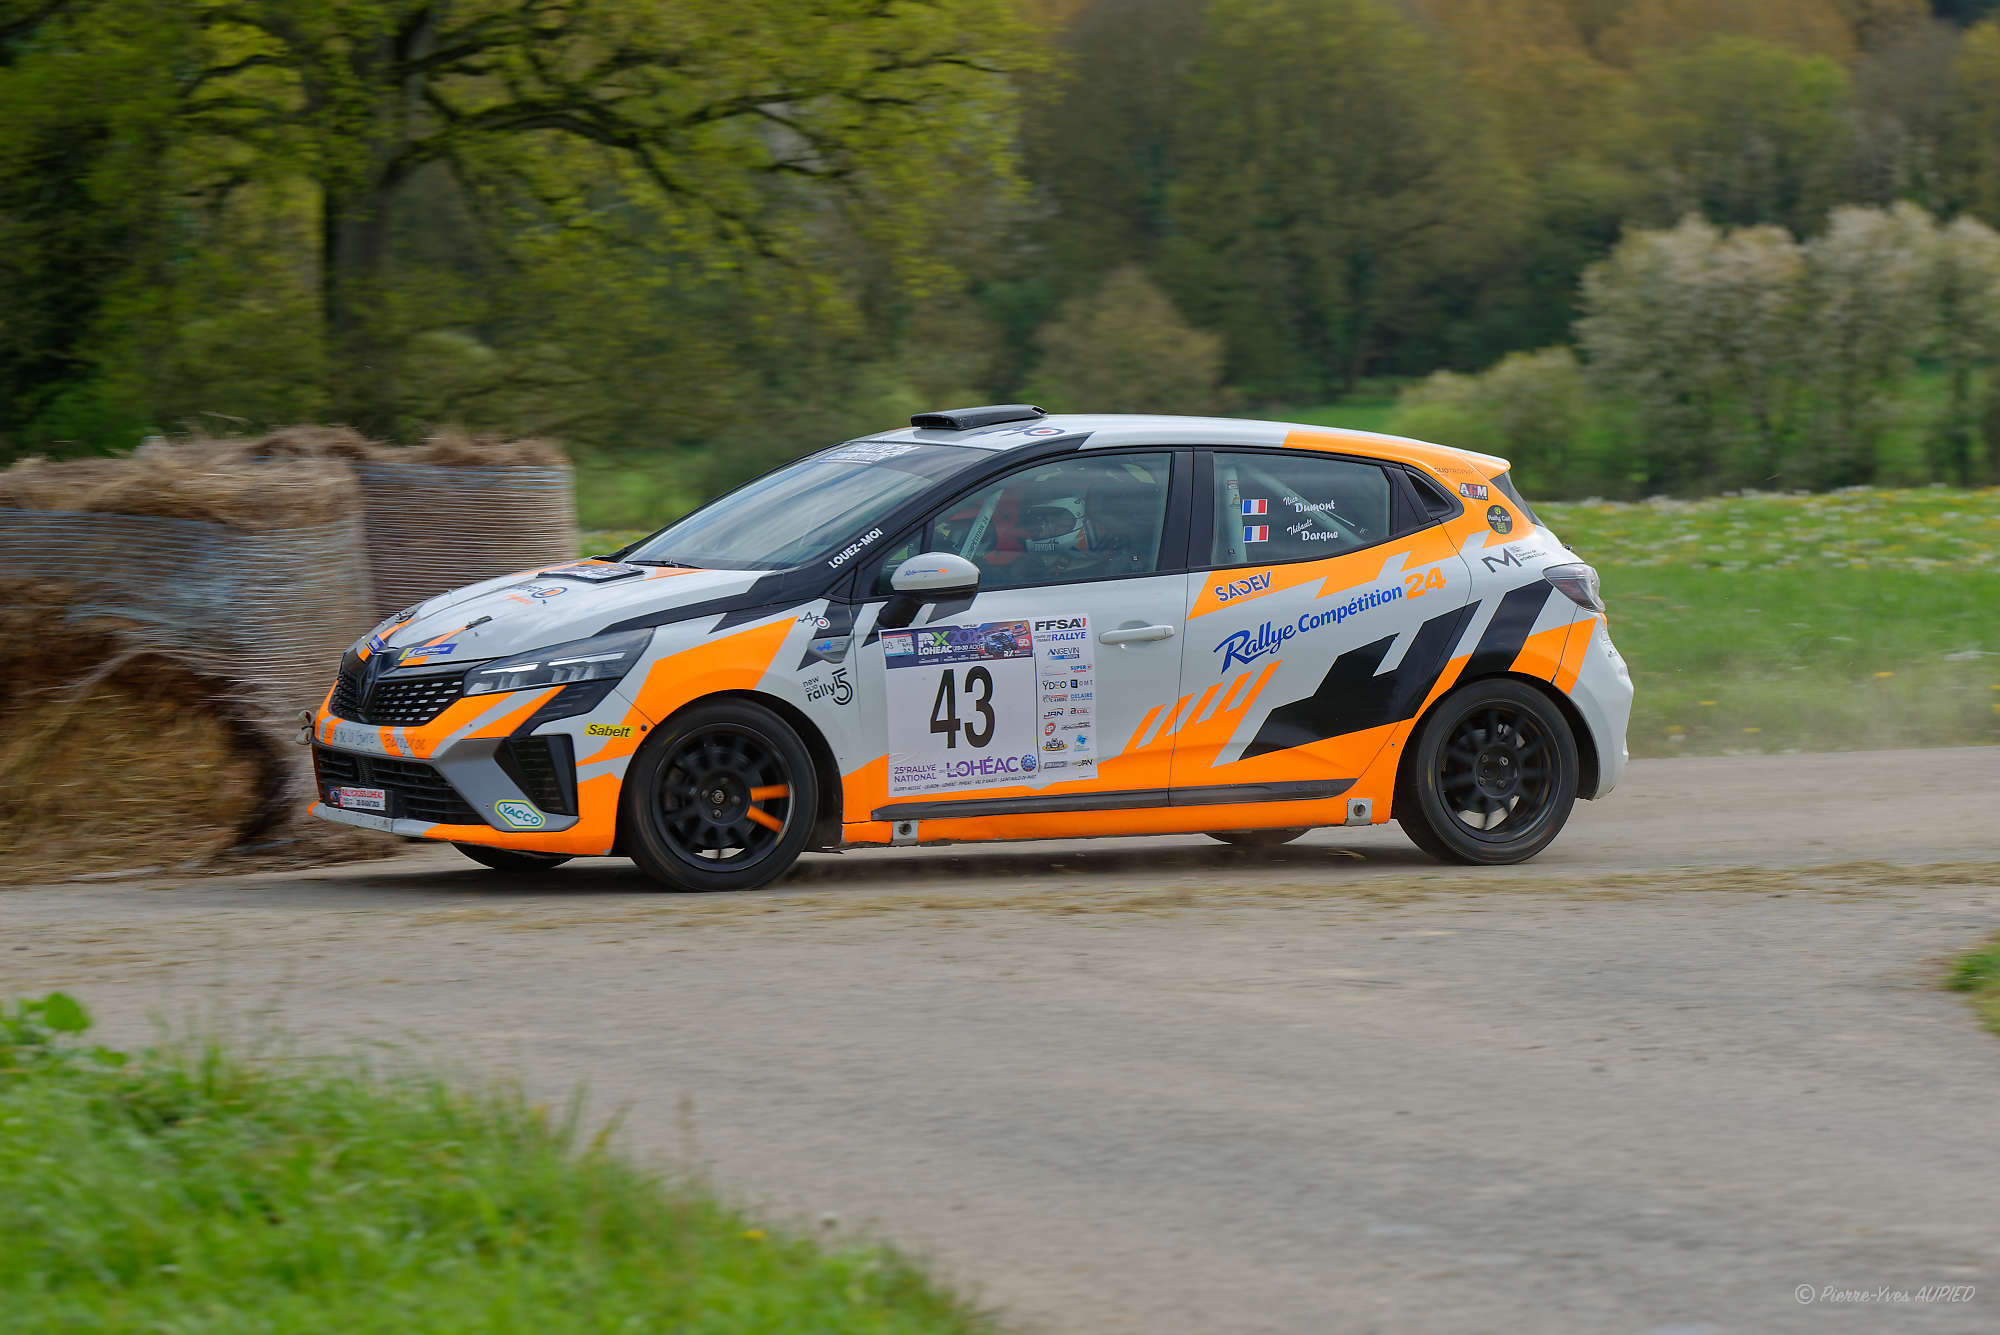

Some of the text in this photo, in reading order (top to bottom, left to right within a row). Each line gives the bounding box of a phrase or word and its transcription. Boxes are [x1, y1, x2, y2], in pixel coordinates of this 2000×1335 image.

[1295, 499, 1335, 513] Dumont
[1287, 518, 1313, 536] Thibault
[828, 527, 884, 569] LOUEZ-MOI
[1215, 571, 1272, 601] SADEV
[1035, 618, 1082, 631] FFSA
[1213, 567, 1447, 675] Rallye Compétition 24
[1052, 631, 1087, 641] RALLYE
[930, 665, 995, 749] 43
[588, 724, 631, 738] Sabelt
[946, 756, 1019, 778] LOHÉAC
[894, 772, 937, 783] NATIONAL
[502, 804, 540, 825] YACCO
